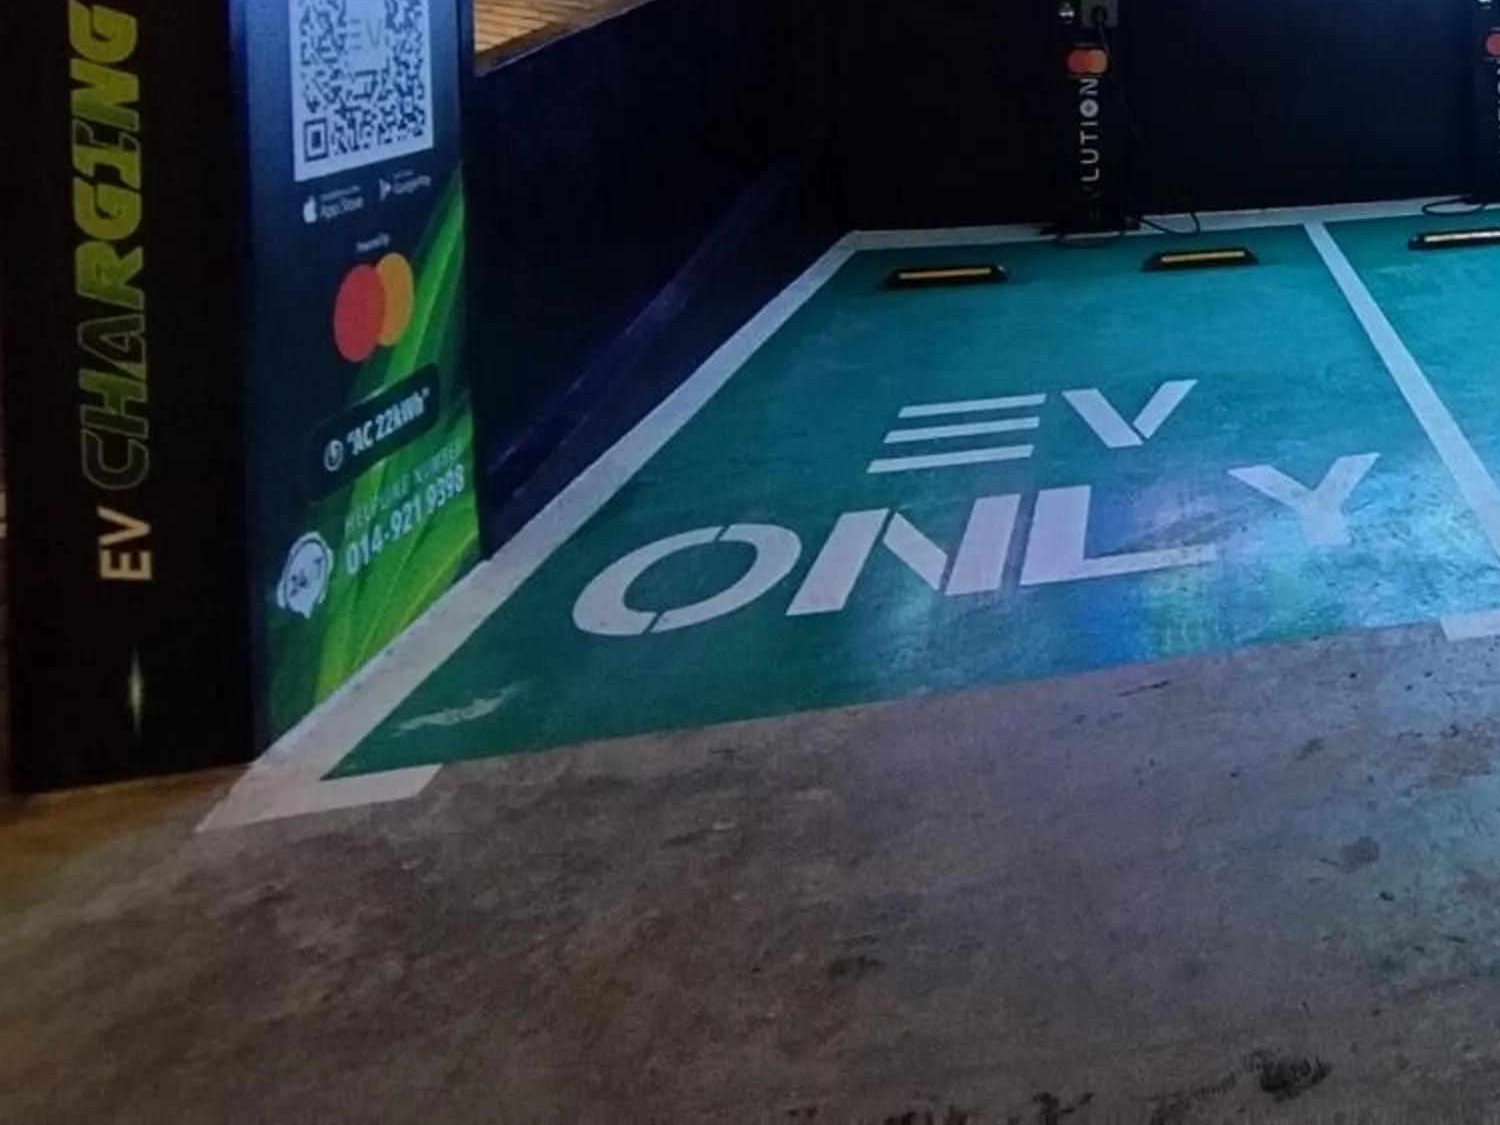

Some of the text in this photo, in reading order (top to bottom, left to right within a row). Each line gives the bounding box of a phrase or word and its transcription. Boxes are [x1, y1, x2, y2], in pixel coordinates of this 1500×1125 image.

[868, 379, 1198, 474] EV
[100, 507, 151, 580] EV
[346, 495, 422, 575] 014-921
[572, 452, 1380, 636] ONLY
